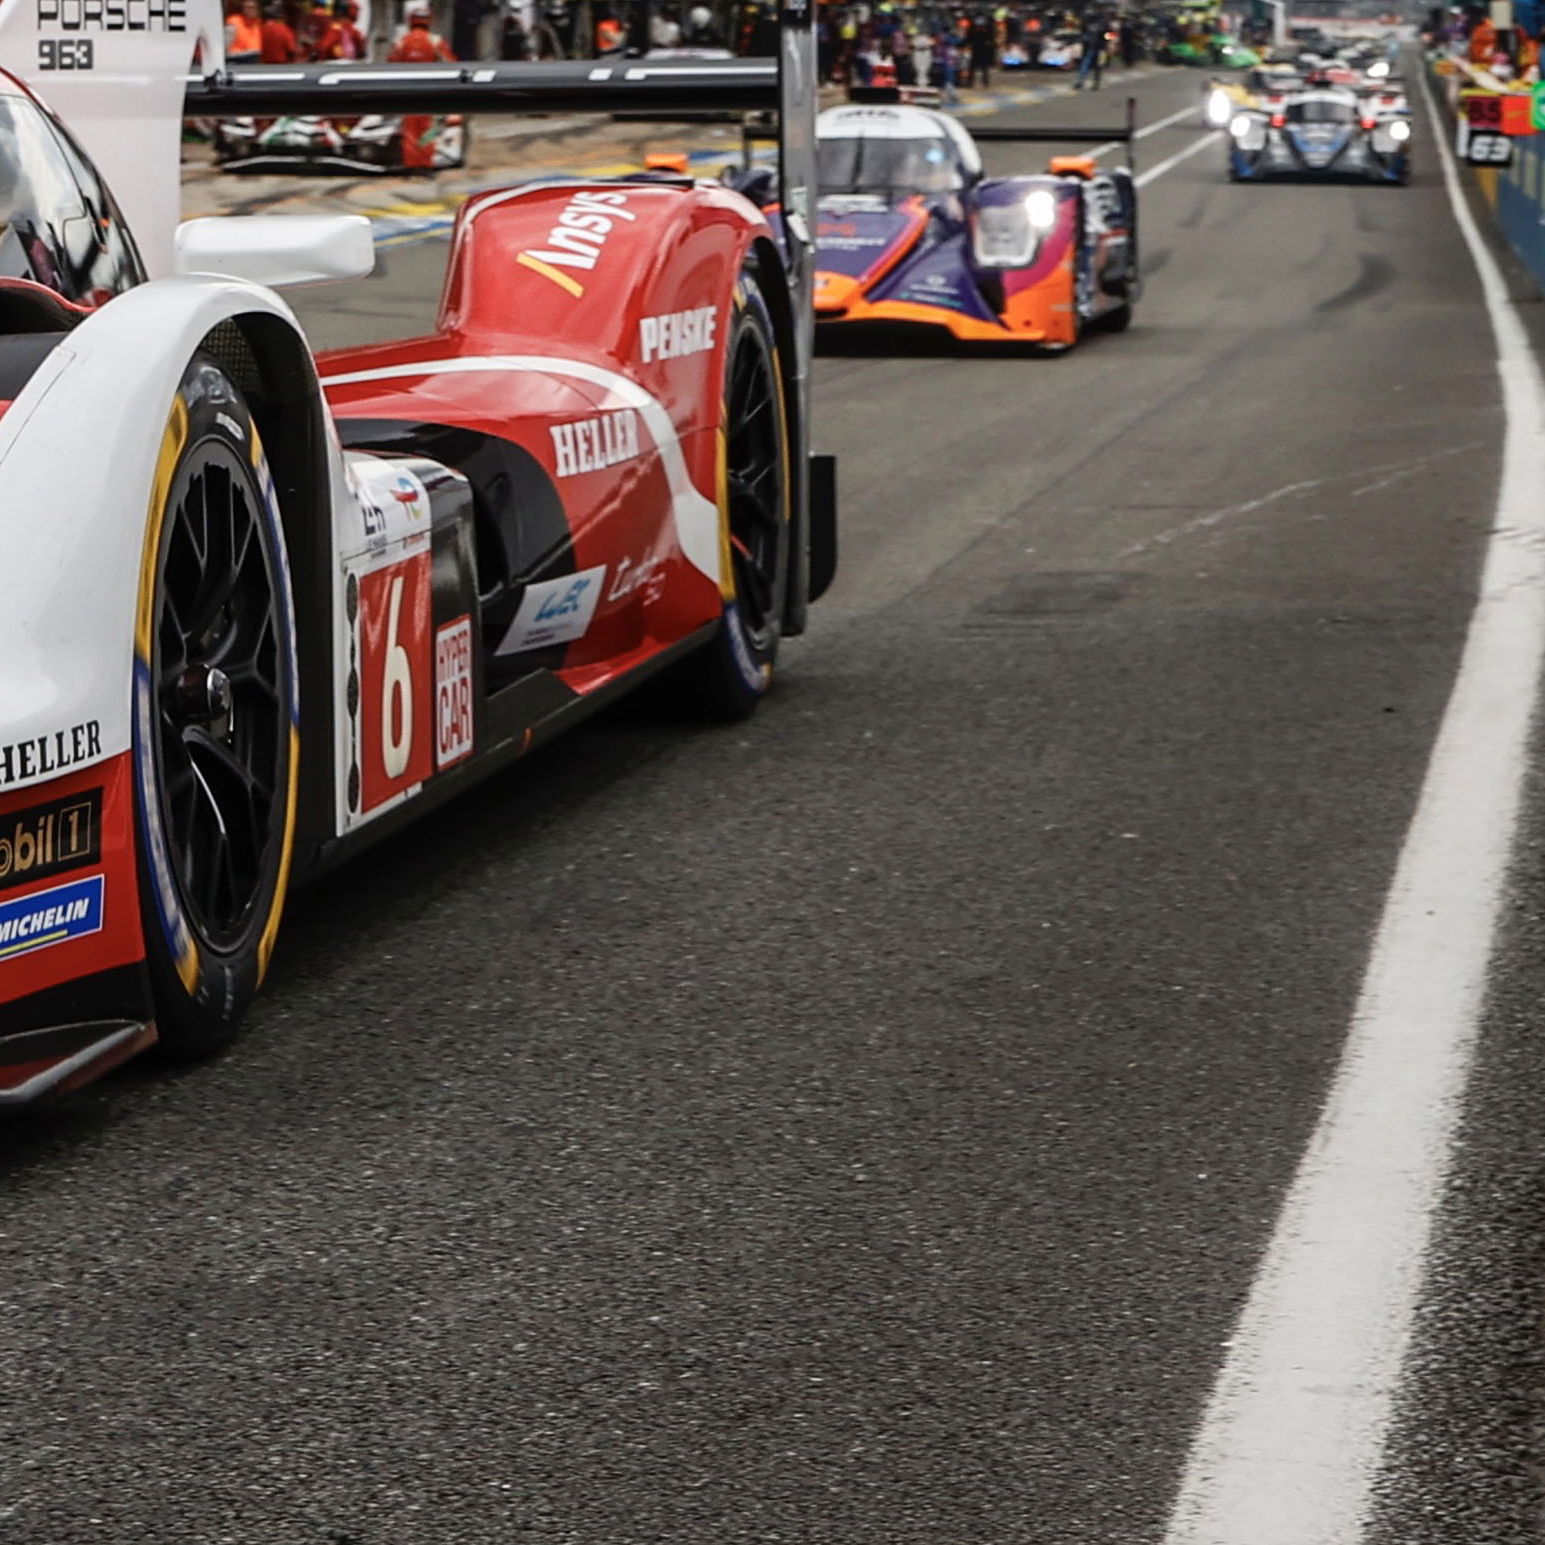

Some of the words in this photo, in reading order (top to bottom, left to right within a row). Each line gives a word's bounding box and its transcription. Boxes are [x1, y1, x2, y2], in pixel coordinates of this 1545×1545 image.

[39, 40, 93, 70] 963
[516, 191, 636, 298] Ansys
[639, 306, 717, 363] PENSKE
[550, 409, 640, 477] HELLER
[382, 576, 412, 779] 6
[439, 676, 470, 755] CAR
